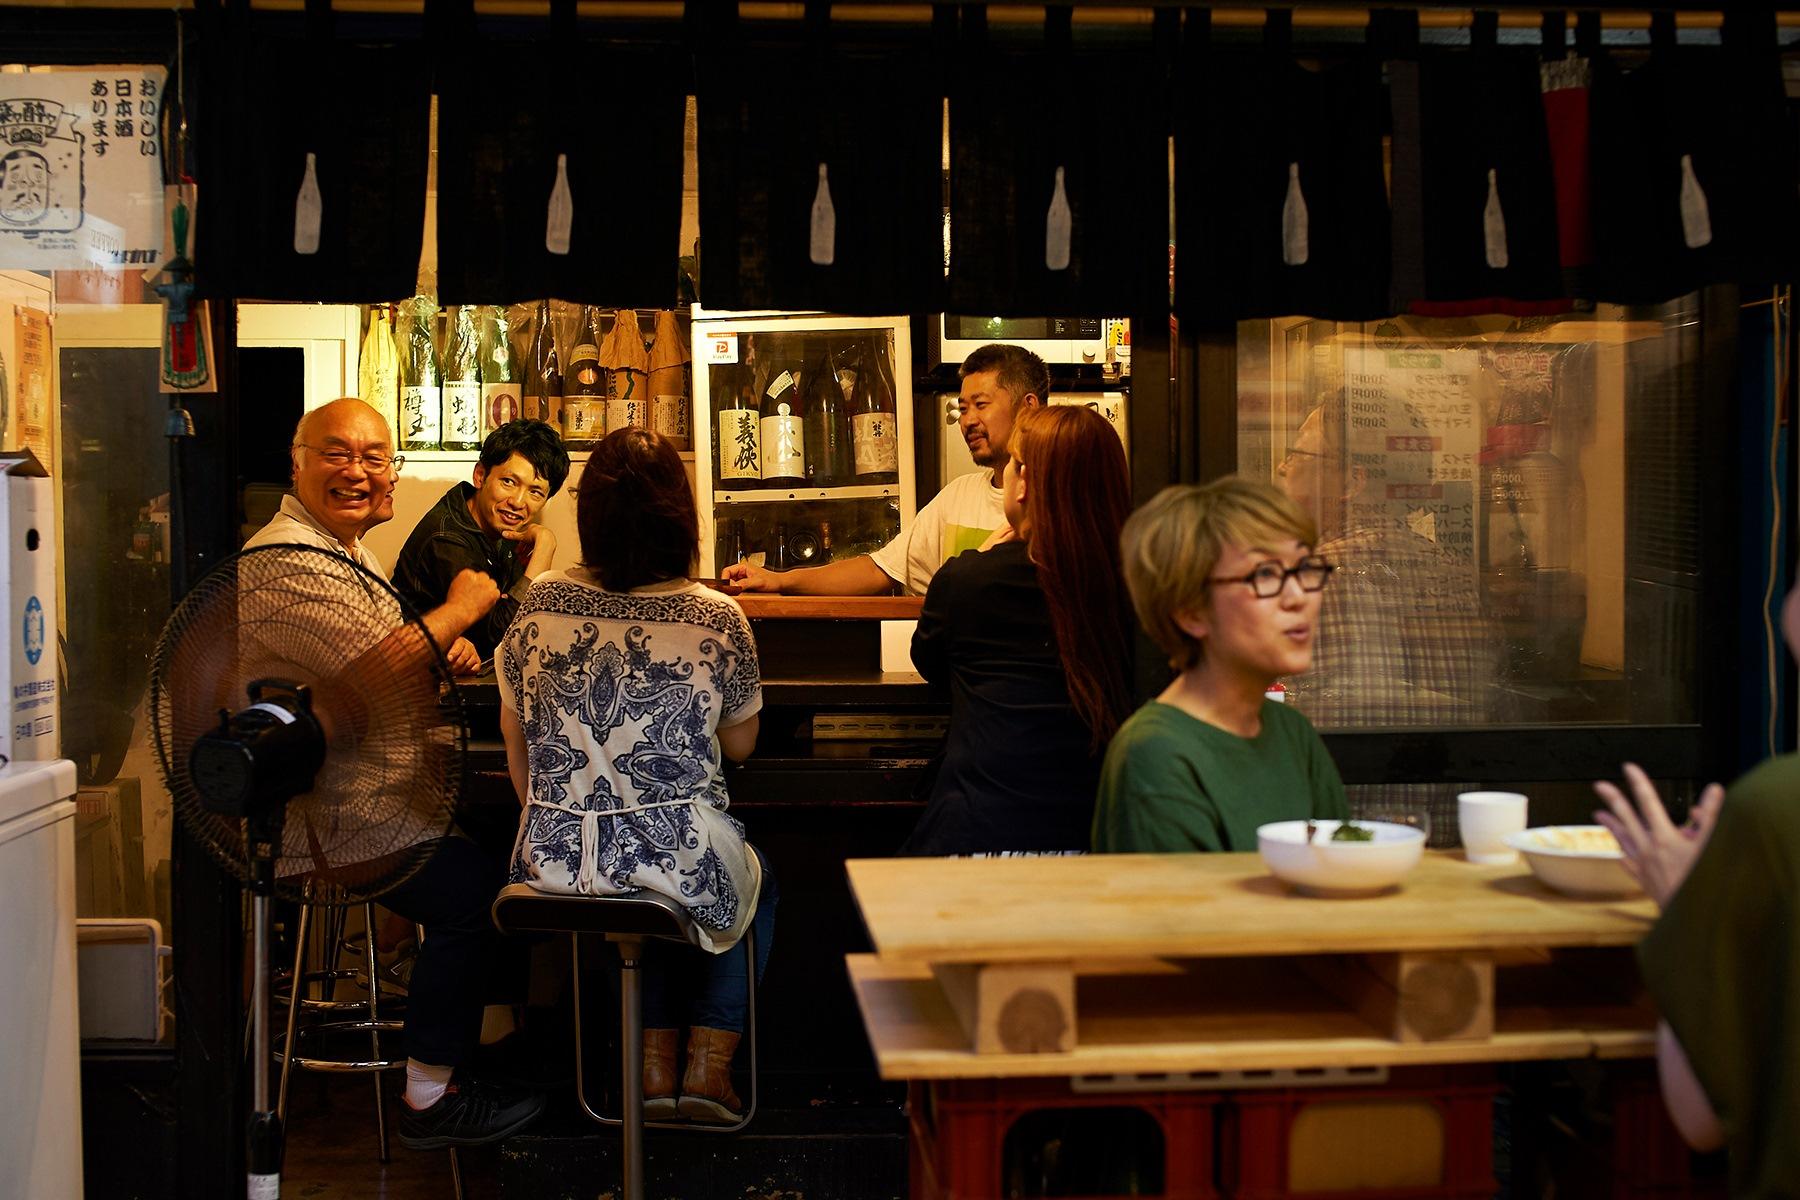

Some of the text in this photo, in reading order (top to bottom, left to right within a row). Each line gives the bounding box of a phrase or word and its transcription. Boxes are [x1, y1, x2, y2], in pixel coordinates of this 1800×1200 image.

[90, 79, 109, 157] あります
[115, 79, 134, 137] 日本酒
[140, 79, 157, 156] おいしい
